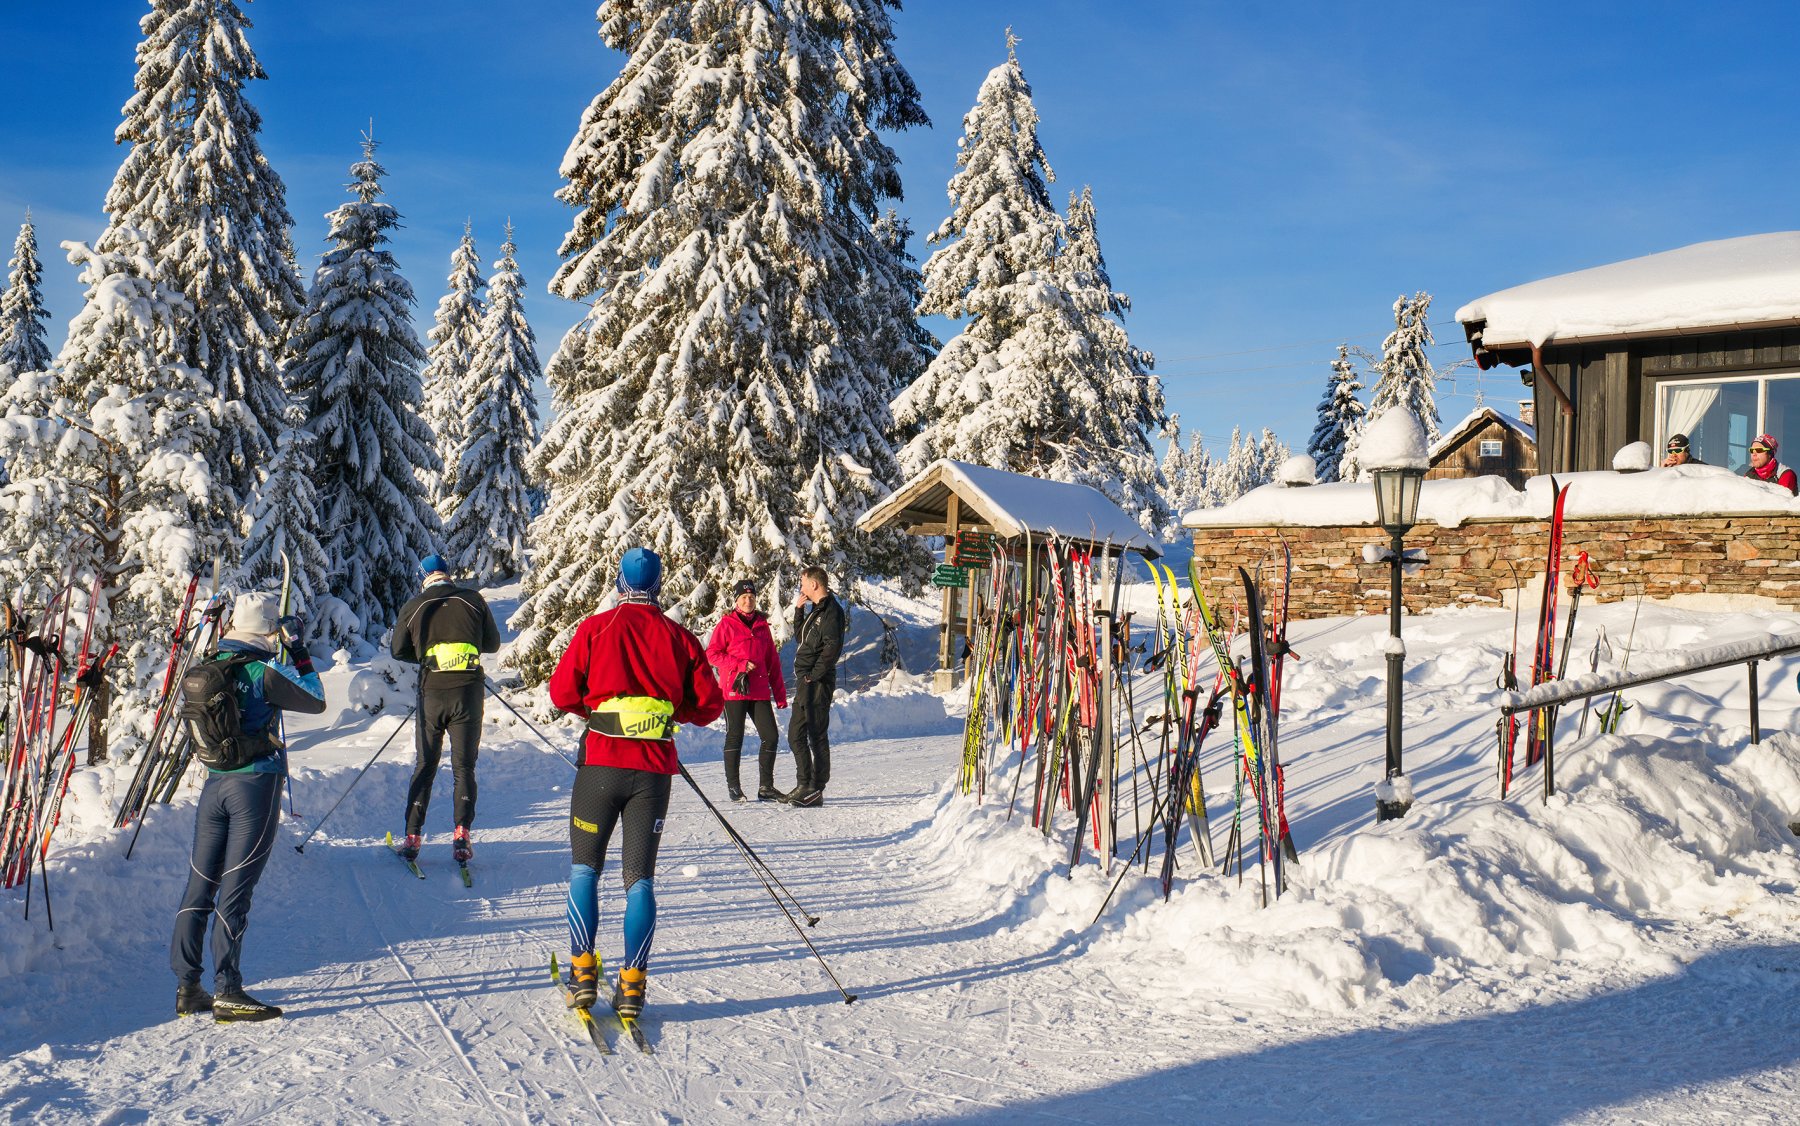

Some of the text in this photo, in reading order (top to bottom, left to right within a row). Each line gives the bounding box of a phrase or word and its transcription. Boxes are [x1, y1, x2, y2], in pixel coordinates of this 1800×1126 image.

[1553, 523, 1561, 569] FISCHER
[1073, 560, 1084, 625] ATOMIC
[1084, 564, 1094, 628] ATOMIC
[1175, 610, 1189, 680] FISCHER
[50, 796, 60, 825] MADSHUS
